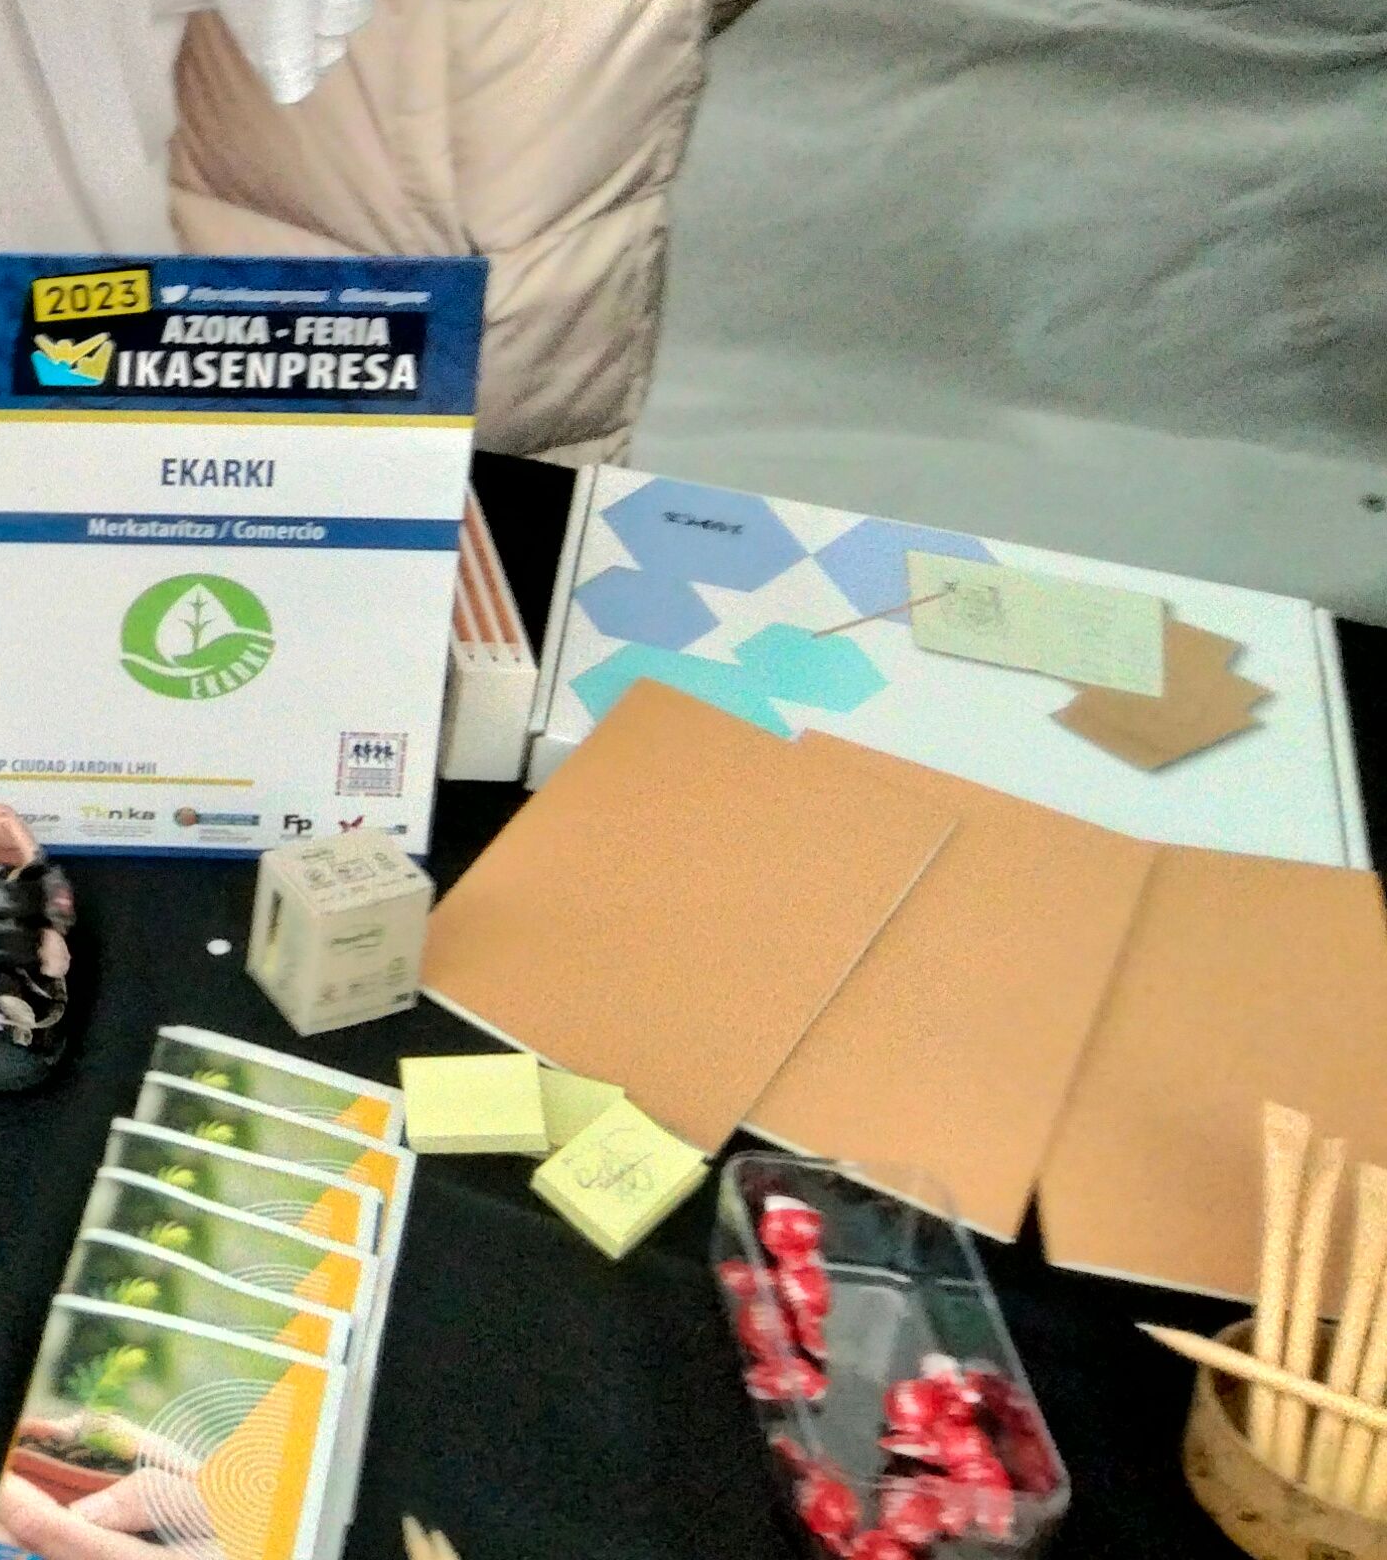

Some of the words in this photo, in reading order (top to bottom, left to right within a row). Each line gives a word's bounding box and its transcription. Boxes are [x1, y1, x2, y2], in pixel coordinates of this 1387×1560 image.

[45, 280, 140, 316] 2023
[161, 316, 271, 345] AZOKA
[294, 317, 391, 346] FERIA
[116, 349, 419, 391] IKASENPRESA
[160, 458, 275, 489] EKARKI
[232, 521, 327, 541] Comercio
[191, 642, 275, 699] EKARKI
[11, 759, 66, 774] CIUDAD
[69, 760, 124, 775] JARDIN
[282, 814, 313, 833] Fp
